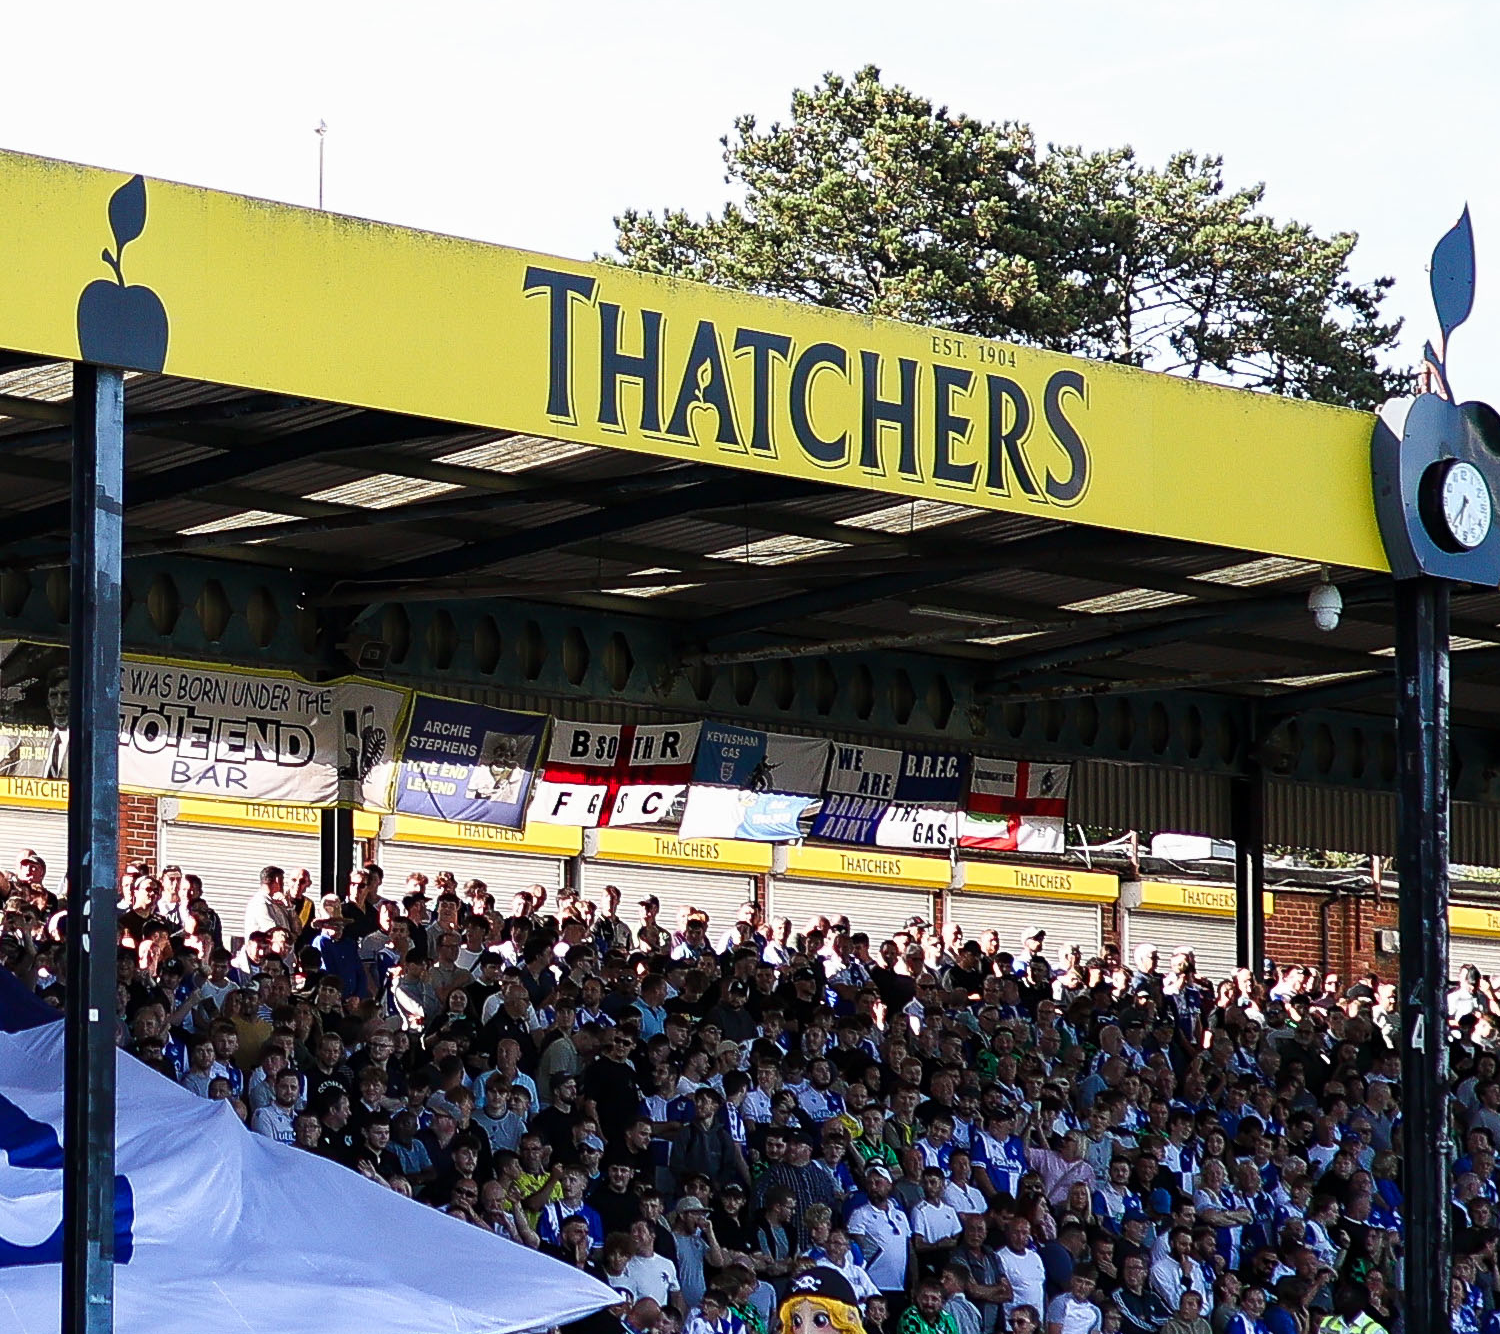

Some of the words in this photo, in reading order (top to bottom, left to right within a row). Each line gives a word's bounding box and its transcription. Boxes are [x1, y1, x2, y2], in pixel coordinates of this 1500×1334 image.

[931, 334, 967, 360] EST.
[978, 344, 1017, 368] 1904
[522, 266, 1091, 508] THATCHERS
[131, 669, 172, 699] WAS
[177, 675, 227, 704] BORN
[232, 681, 290, 712] UNDER
[297, 688, 332, 715] THE
[119, 702, 214, 760] TOTE
[214, 717, 316, 767] END
[424, 720, 472, 739] ARCHIE
[707, 730, 760, 747] KEYNSHAM
[409, 735, 478, 757] STEPHENS
[570, 730, 591, 758] B
[660, 730, 682, 759] R
[721, 746, 741, 760] GAS
[406, 759, 438, 773] TOTE
[439, 761, 469, 780] END
[838, 747, 865, 772] WE
[905, 753, 960, 779] B.R.F.C.
[171, 761, 248, 790] BAR
[406, 776, 457, 796] LEGEND
[858, 772, 893, 798] ARE
[7, 778, 69, 799] THATCHE
[244, 804, 318, 823] THATCHERS
[551, 791, 573, 816] F
[587, 794, 600, 814] G
[617, 793, 628, 813] S
[641, 791, 663, 815] C
[824, 793, 889, 820] BARMY
[890, 803, 925, 823] THE
[820, 817, 873, 845] ARMY
[654, 837, 720, 860] THATCHERS
[840, 854, 901, 875] THATCHERS
[1014, 870, 1072, 891] THATCHERS
[1181, 888, 1236, 907] THATCHERS
